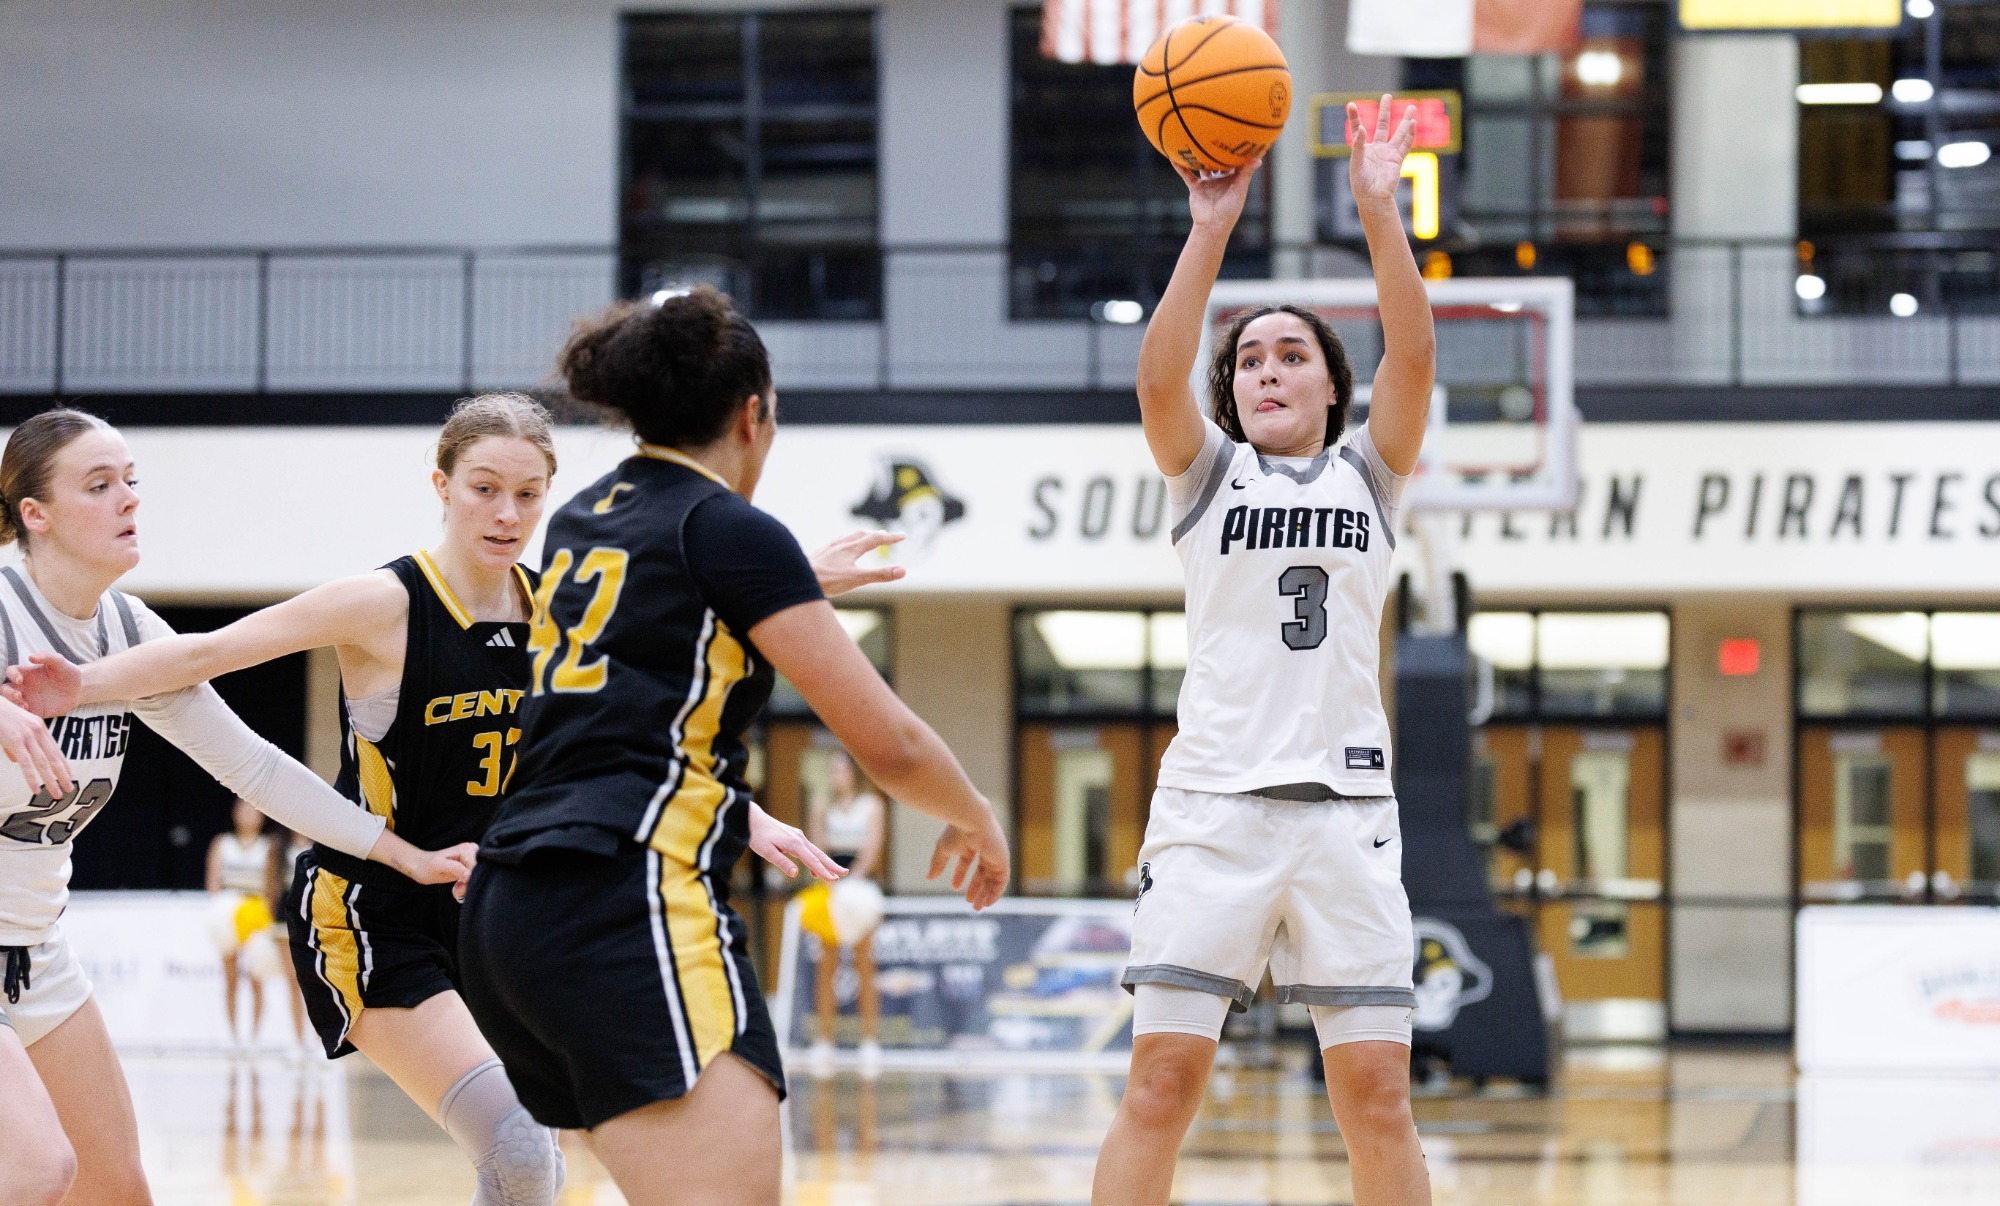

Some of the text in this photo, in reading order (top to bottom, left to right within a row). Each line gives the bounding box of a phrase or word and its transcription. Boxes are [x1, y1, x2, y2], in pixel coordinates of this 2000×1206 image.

[1220, 505, 1370, 555] PIRATES
[1692, 472, 2000, 540] PIRATES
[527, 547, 629, 698] 42
[1278, 565, 1329, 651] 3
[44, 712, 132, 760] IRATES
[0, 778, 113, 845] 23
